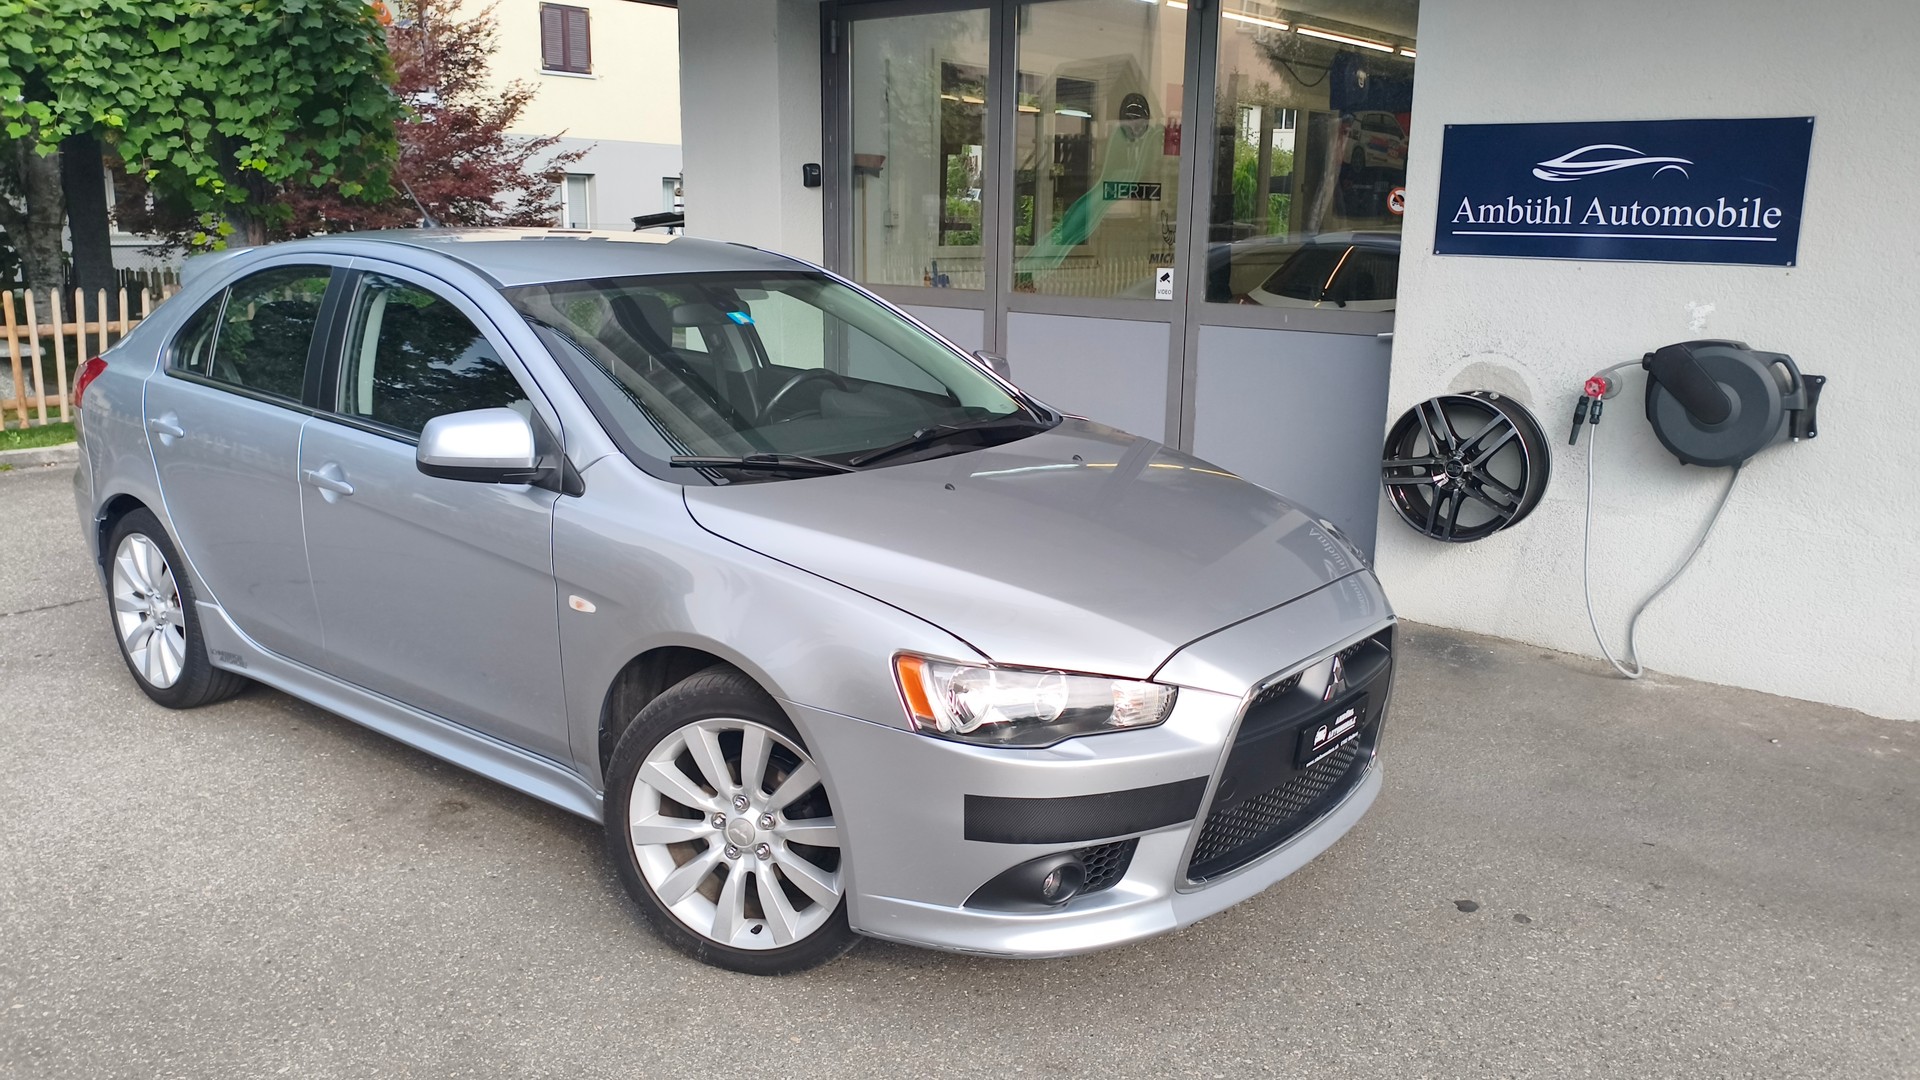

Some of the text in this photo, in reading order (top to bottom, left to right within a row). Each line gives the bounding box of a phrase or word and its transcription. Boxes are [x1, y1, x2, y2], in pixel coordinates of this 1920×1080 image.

[1104, 183, 1161, 199] HERTZ
[1451, 196, 1782, 229] Ambühl Automobile
